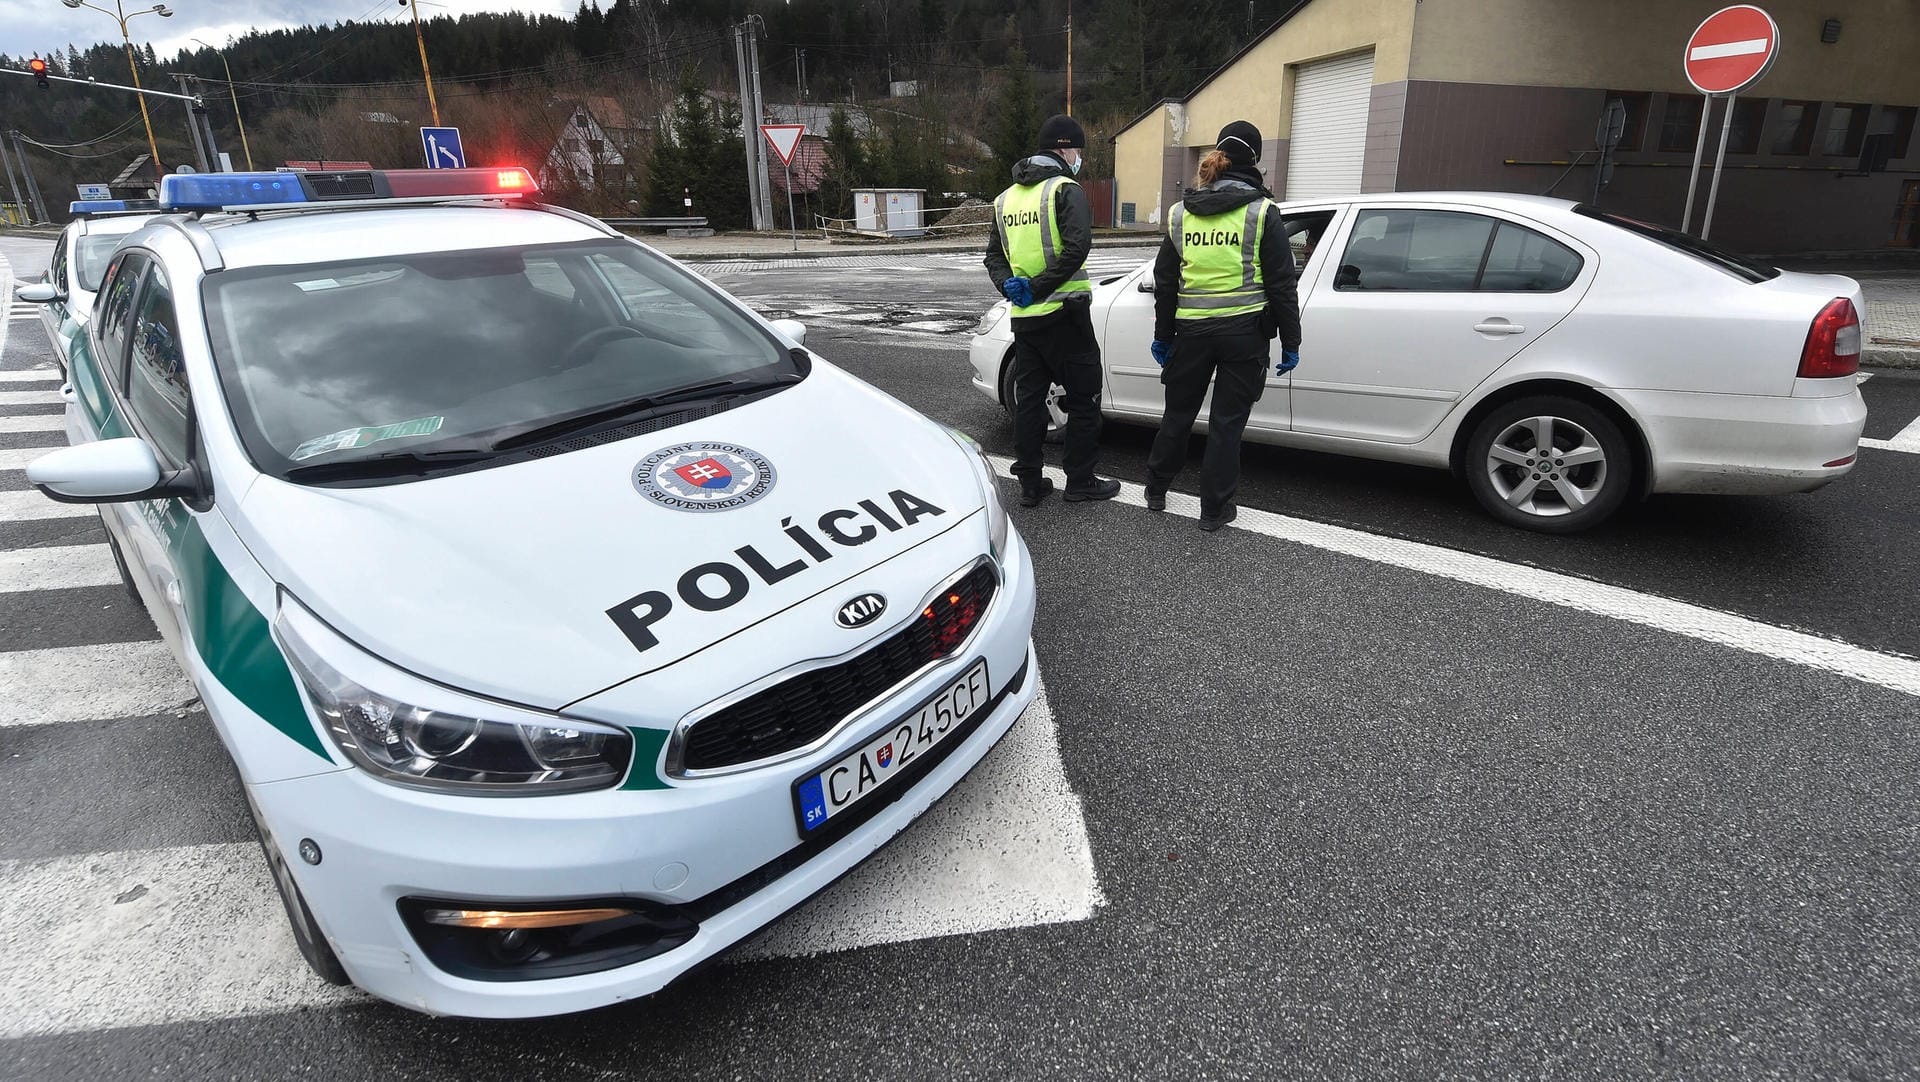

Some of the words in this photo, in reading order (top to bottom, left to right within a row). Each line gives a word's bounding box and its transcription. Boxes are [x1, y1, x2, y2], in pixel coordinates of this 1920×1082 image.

[1003, 210, 1039, 227] POLÍCIA
[1185, 228, 1240, 247] POLÍCIA
[637, 443, 694, 485] POLICAJNÝ
[701, 443, 745, 455] ZBOR
[649, 490, 747, 510] SLOVENSKEJ
[746, 457, 772, 499] REPUBLIKY
[604, 489, 947, 653] POLÍCIA
[841, 595, 883, 624] KIA
[828, 752, 877, 806] CA
[895, 667, 982, 766] 245CF
[807, 805, 822, 822] SK
